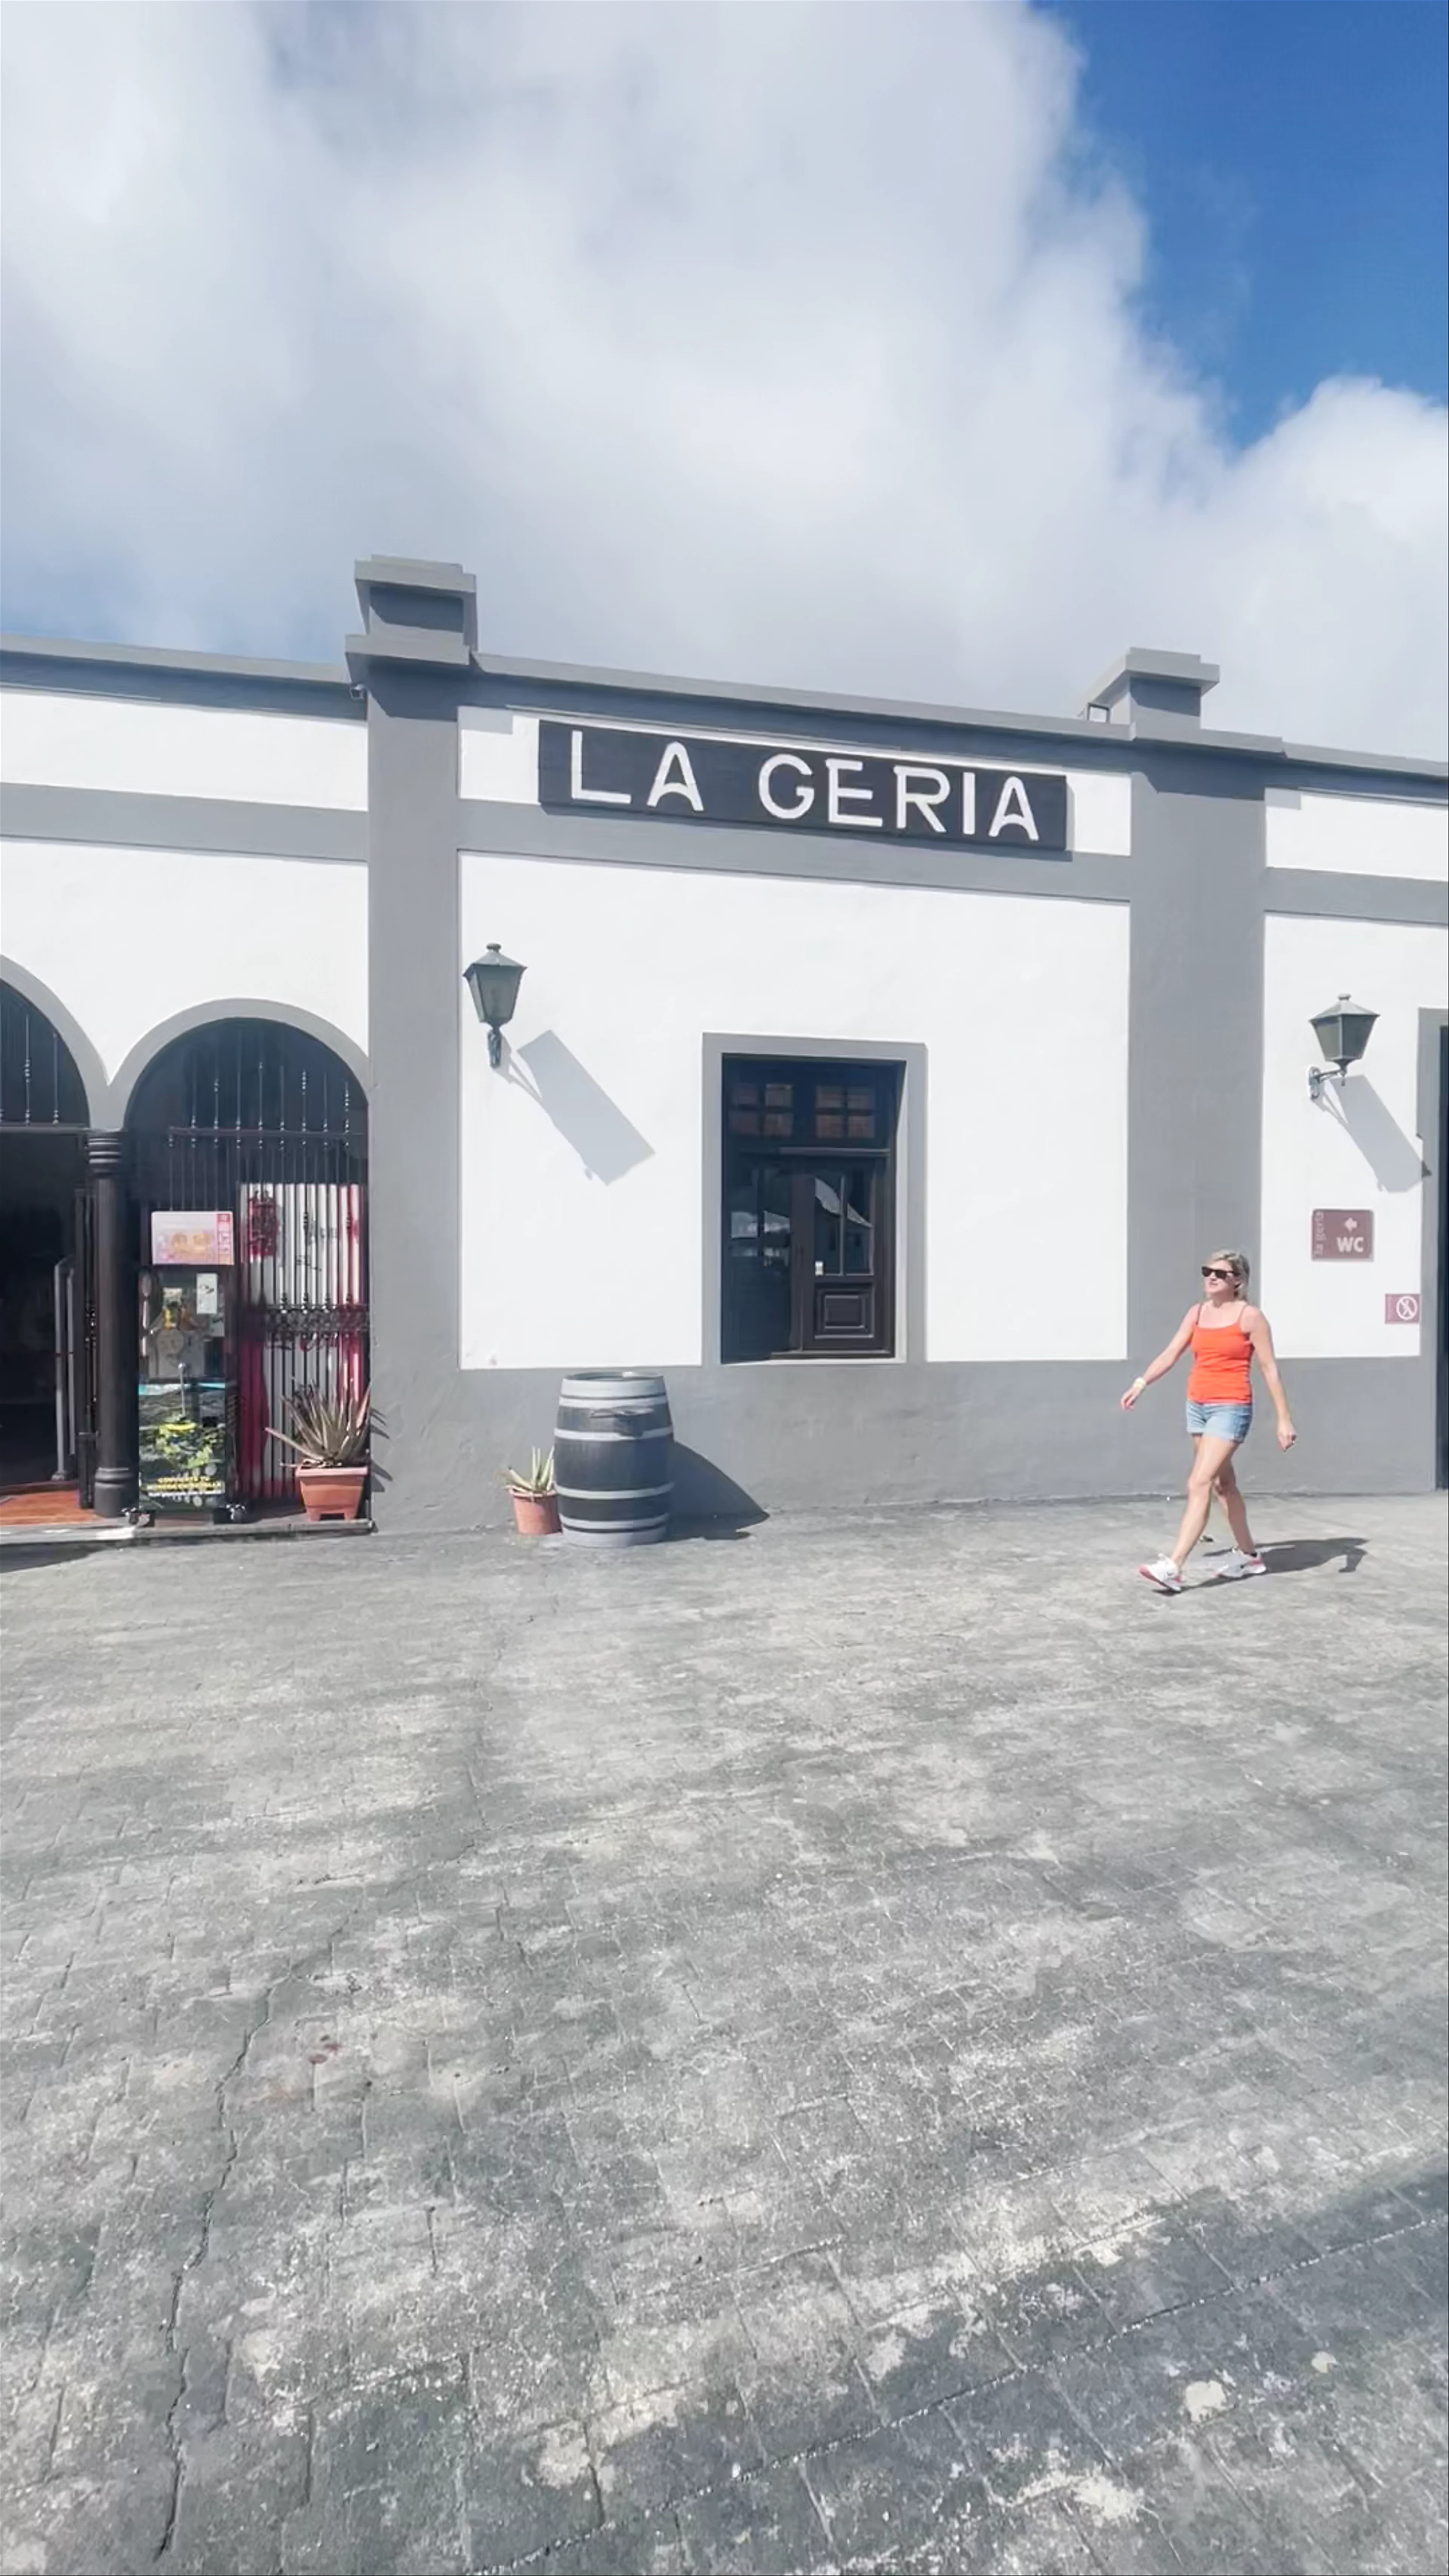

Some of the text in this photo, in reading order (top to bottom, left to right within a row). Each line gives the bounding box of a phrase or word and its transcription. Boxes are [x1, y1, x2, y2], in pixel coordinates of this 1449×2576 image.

[571, 730, 1040, 841] LA GERIA
[1336, 1236, 1364, 1253] WC
